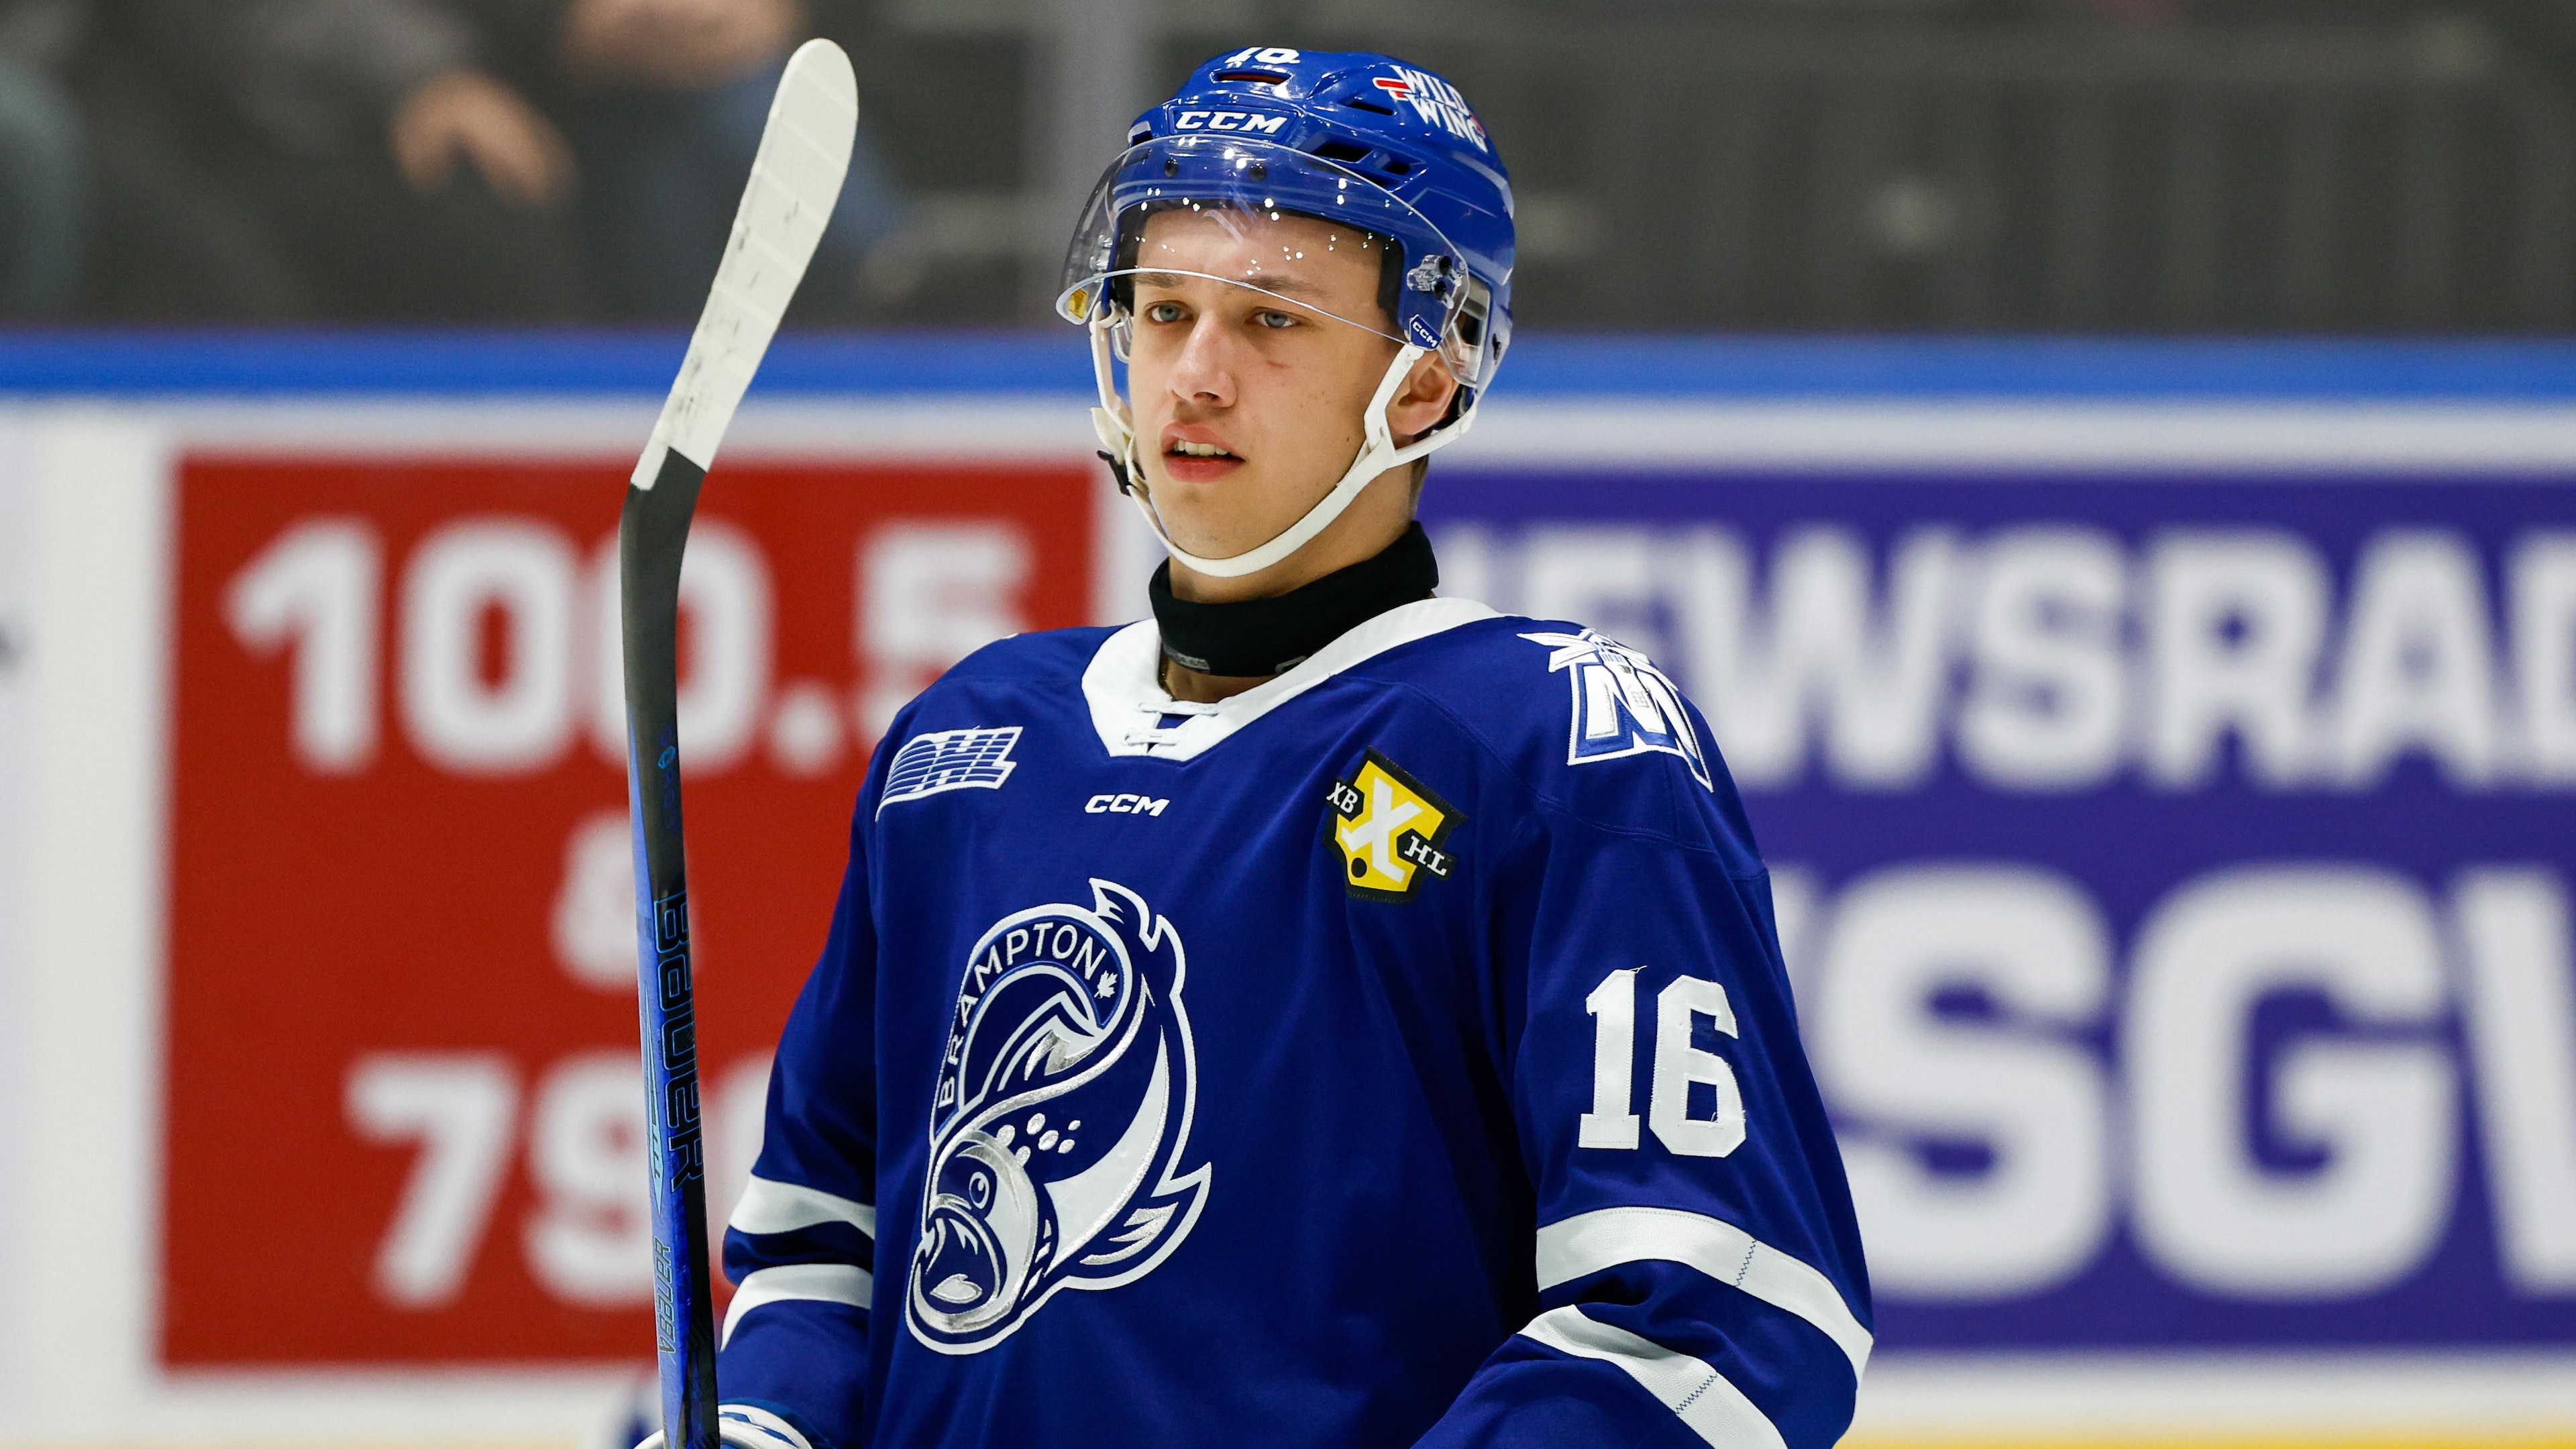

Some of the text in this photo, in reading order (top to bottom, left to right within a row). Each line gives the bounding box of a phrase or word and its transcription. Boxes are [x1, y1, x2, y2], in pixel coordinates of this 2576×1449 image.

[1175, 111, 1288, 134] CCM
[1389, 64, 1470, 117] WILD
[1403, 93, 1489, 154] WING
[1411, 321, 1439, 348] CCM
[224, 518, 1036, 775] 100.5
[1085, 794, 1170, 816] CCM
[1326, 775, 1447, 883] XB X HL
[938, 922, 1107, 1108] BRAMPTON
[1578, 967, 1746, 1158] 16
[1764, 862, 2576, 1300] SG
